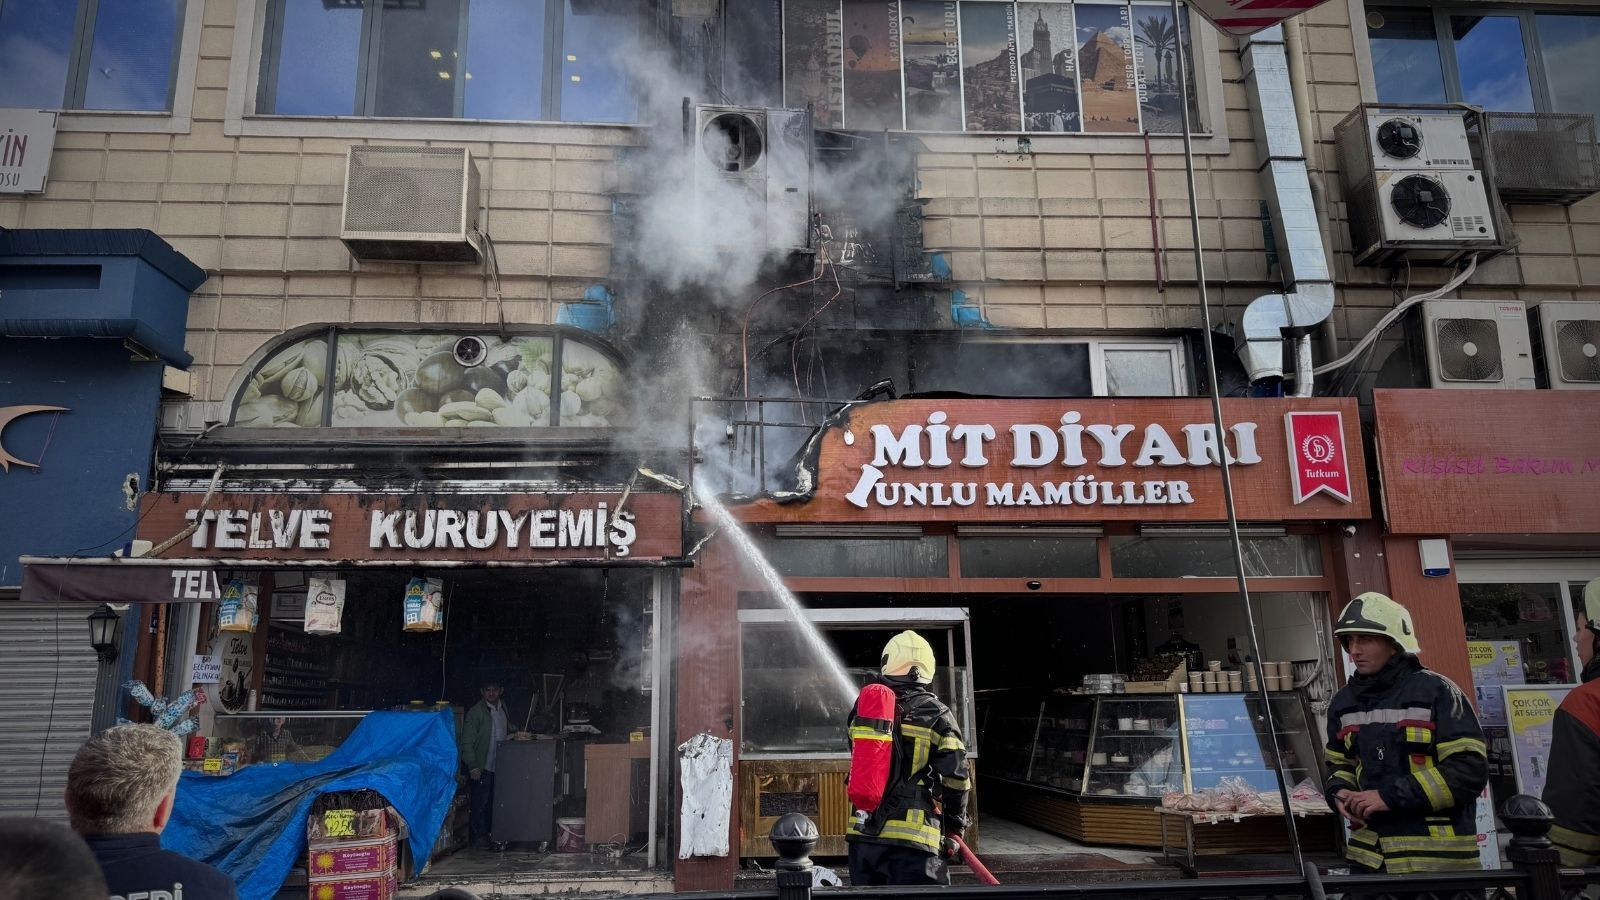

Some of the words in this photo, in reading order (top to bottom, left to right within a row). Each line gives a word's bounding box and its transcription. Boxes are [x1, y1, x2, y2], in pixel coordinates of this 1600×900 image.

[1007, 32, 1017, 83] MEZOPOTAMYA
[1125, 64, 1136, 89] MISIR
[870, 411, 996, 467] MİT
[1009, 410, 1262, 467] DİYARI
[1305, 468, 1339, 478] Tutkum
[874, 482, 978, 506] UNLU
[985, 475, 1195, 506] MAMÜLLER
[185, 509, 333, 550] TELVE
[369, 502, 637, 557] KURUYEMİŞ
[1512, 699, 1531, 708] ÇOK
[1532, 698, 1550, 709] ÇOK
[1514, 709, 1524, 717] AT
[1526, 708, 1553, 717] SEPETE
